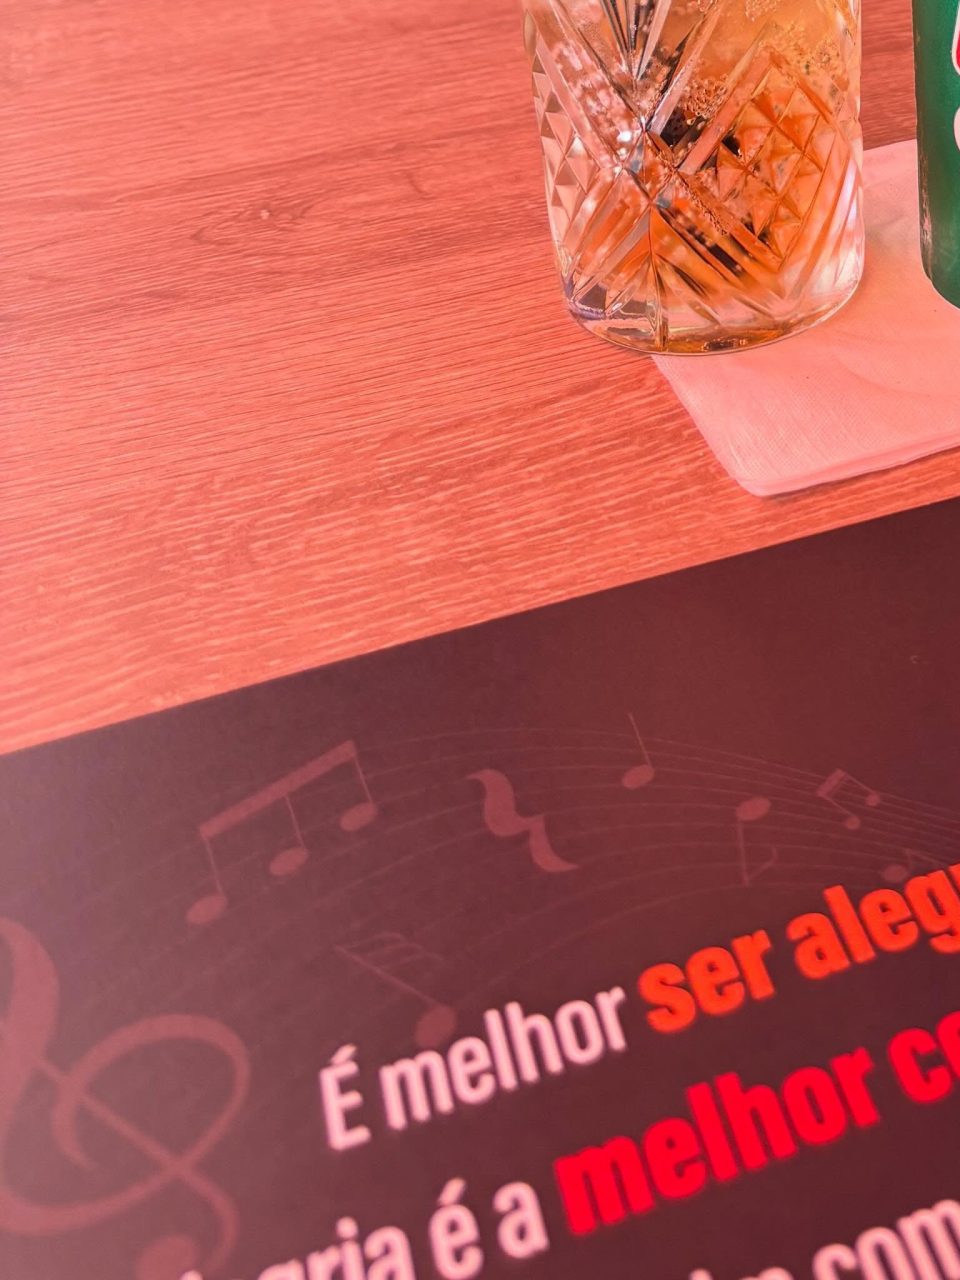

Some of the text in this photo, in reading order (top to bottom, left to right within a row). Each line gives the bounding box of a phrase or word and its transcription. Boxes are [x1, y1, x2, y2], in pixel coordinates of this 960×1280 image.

[318, 1042, 372, 1152] É
[378, 984, 628, 1132] melhor
[637, 926, 776, 1035] ser
[429, 1177, 484, 1280] é
[492, 1180, 551, 1260] a
[553, 1045, 880, 1238] melhor
